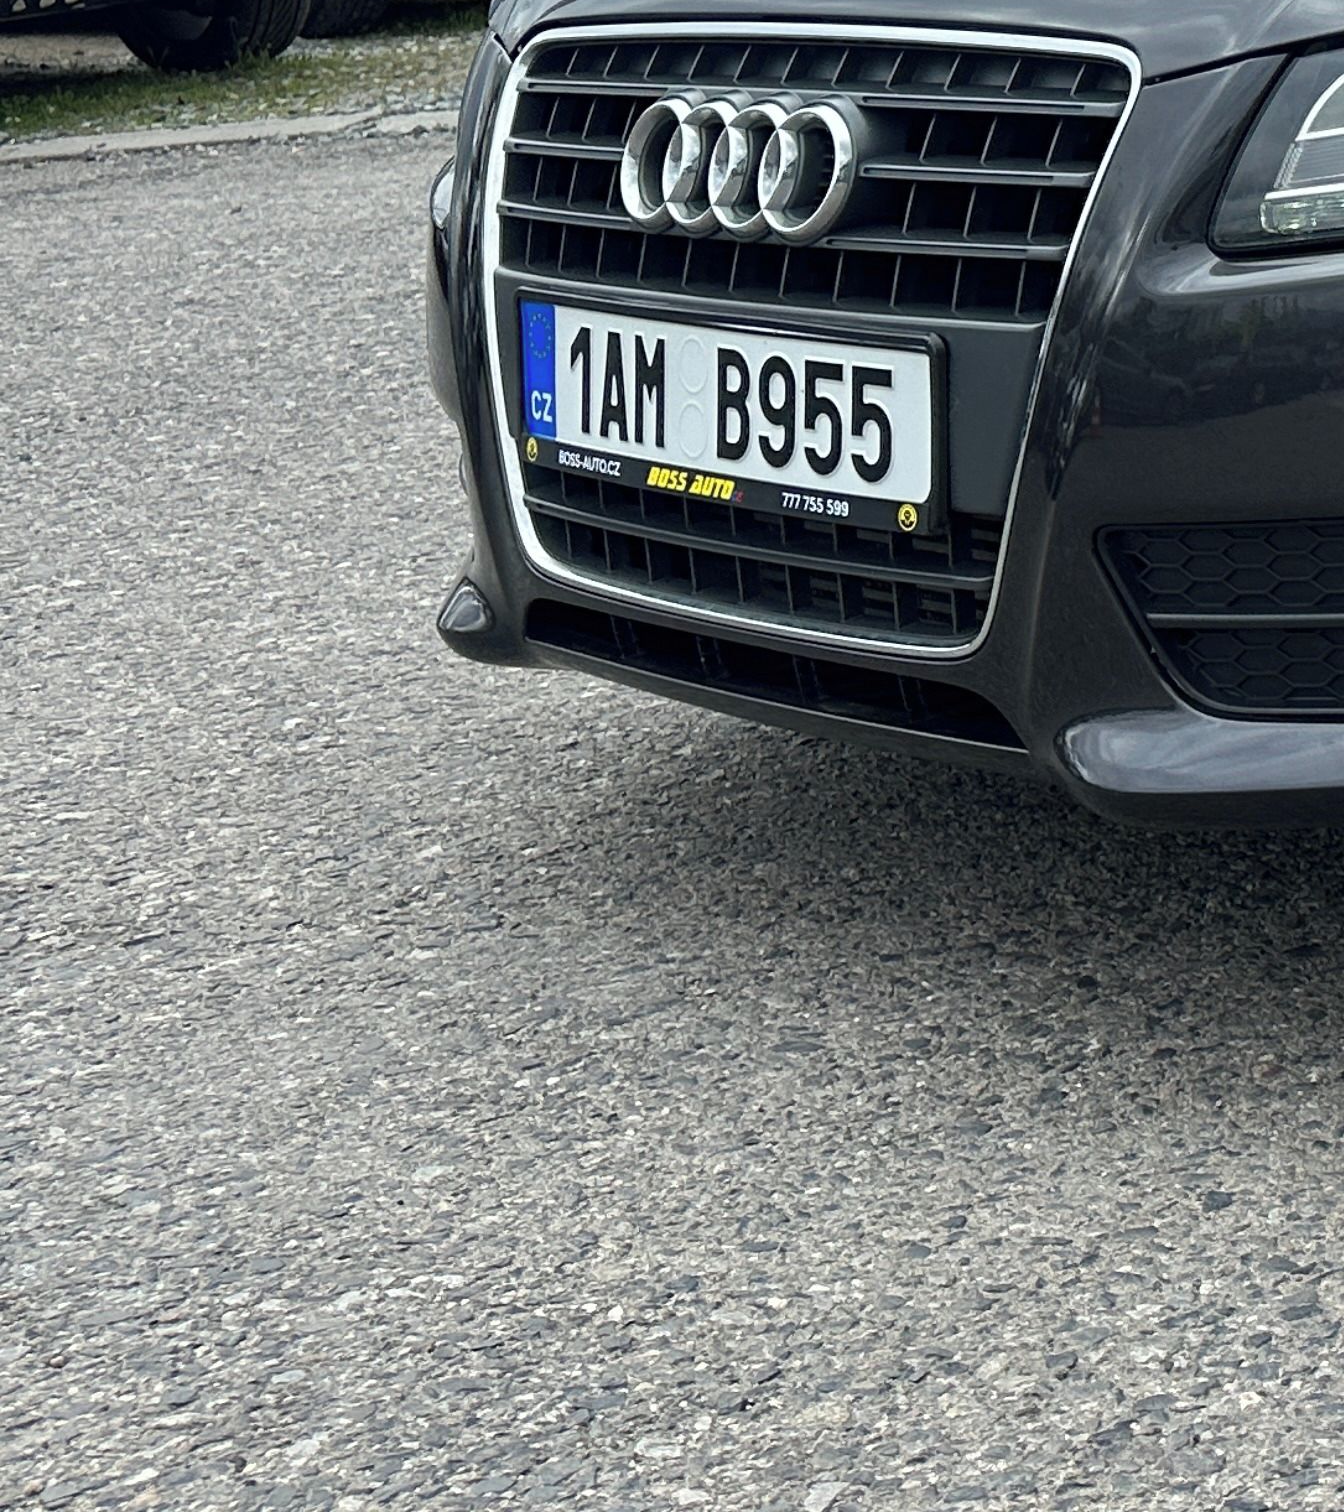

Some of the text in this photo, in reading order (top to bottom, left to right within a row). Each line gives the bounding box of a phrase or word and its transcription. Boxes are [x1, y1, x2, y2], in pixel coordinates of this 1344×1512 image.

[531, 390, 552, 422] CZ
[571, 326, 893, 483] 1AM B955
[558, 449, 621, 476] BOSS-AUTO.CZ
[646, 466, 688, 492] BOSS
[781, 492, 849, 517] 777 755 599
